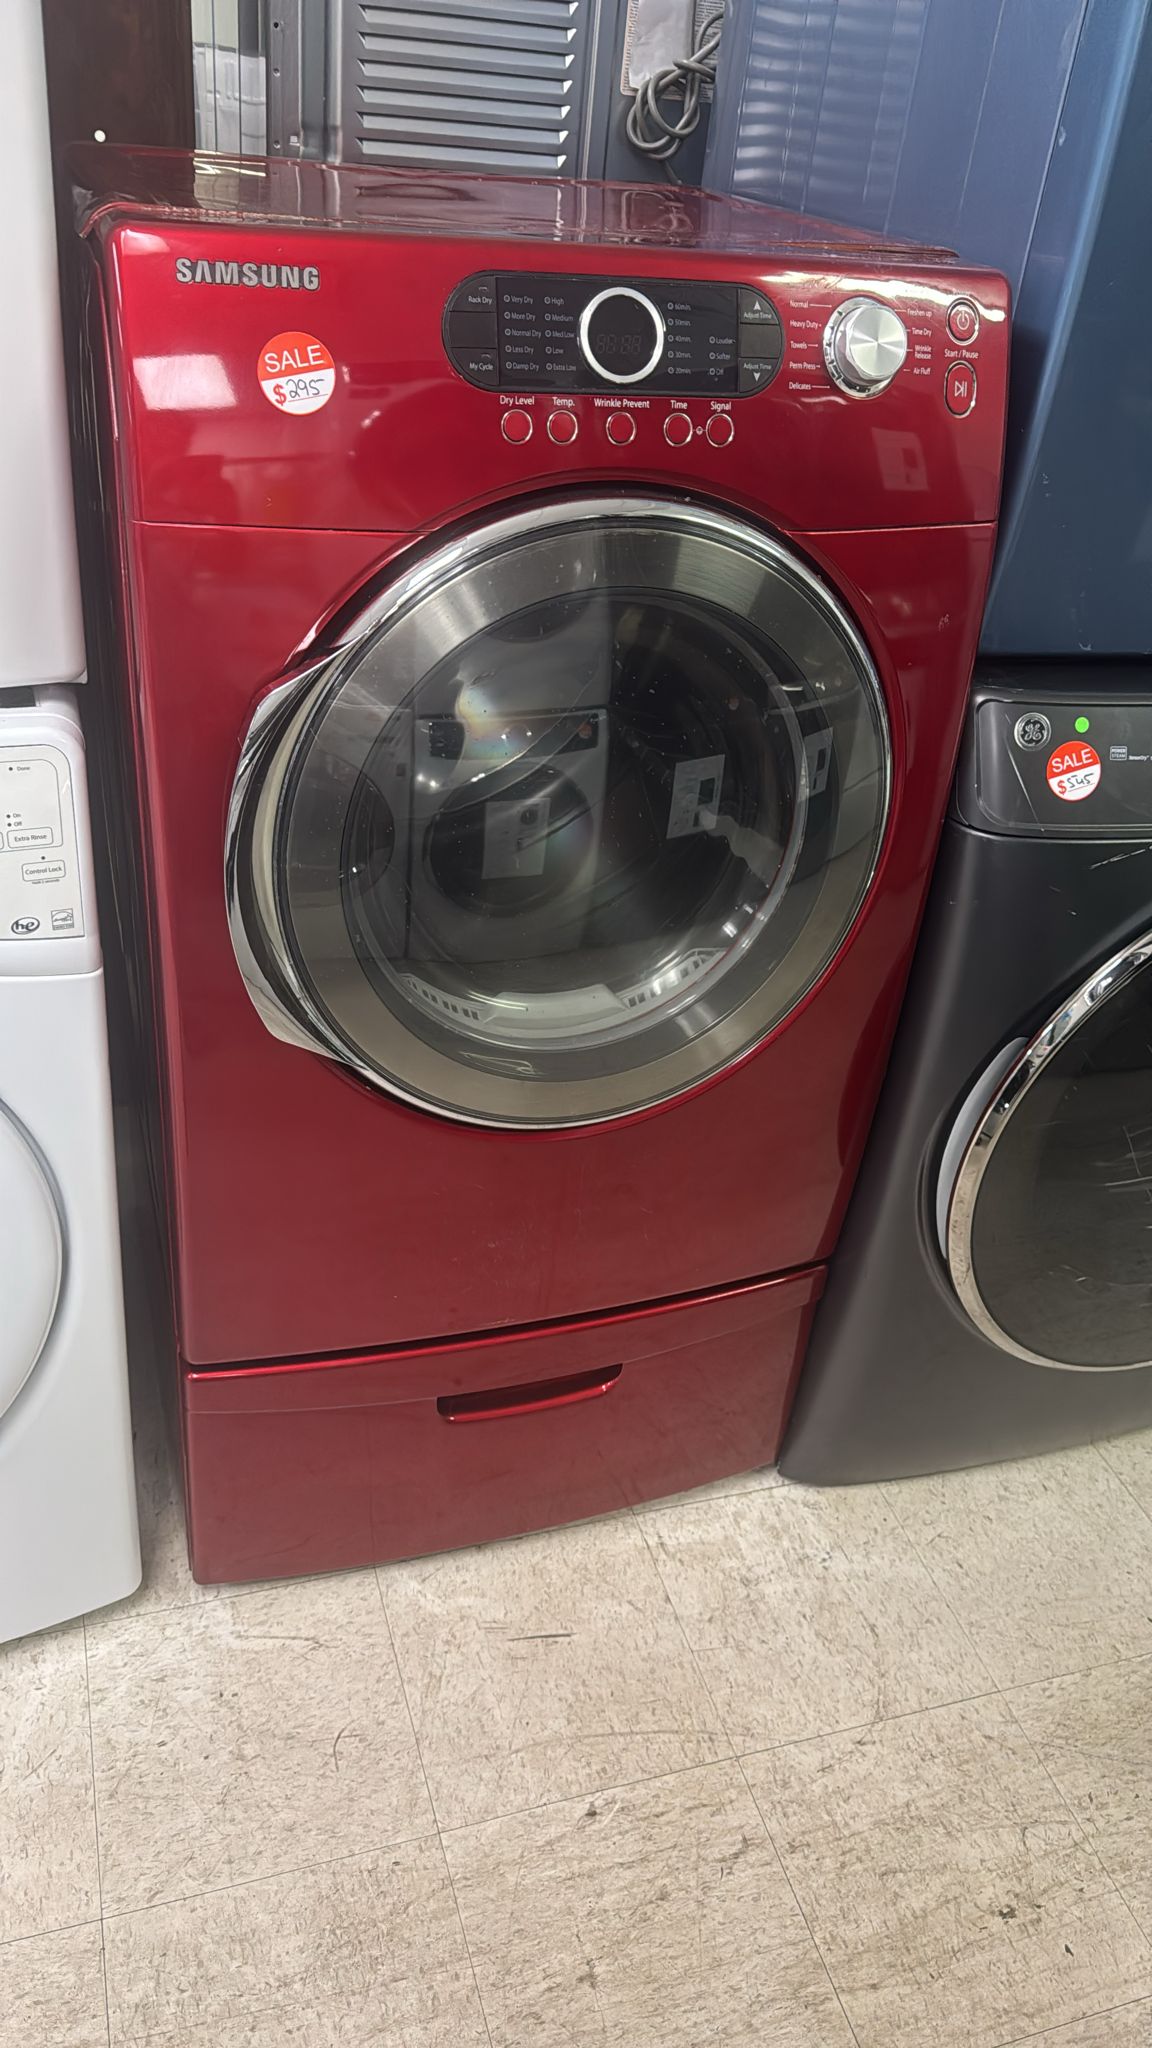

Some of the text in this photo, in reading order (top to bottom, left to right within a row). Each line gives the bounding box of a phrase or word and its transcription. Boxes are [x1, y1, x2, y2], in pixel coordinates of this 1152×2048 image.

[175, 257, 320, 291] SAMSUNG
[482, 297, 493, 305] Dry
[524, 296, 534, 304] Dry
[551, 297, 564, 306] High
[789, 300, 808, 308] Normal
[744, 312, 759, 320] Adjust
[907, 308, 924, 316] Freshen
[526, 313, 536, 321] Dry
[790, 320, 818, 330] Heavy Duty
[512, 328, 542, 338] Normal Dry
[921, 328, 932, 336] Dry
[525, 346, 534, 354] Dry
[790, 341, 807, 350] Towels
[264, 343, 326, 374] SALE
[716, 352, 730, 360] Softer
[944, 349, 958, 358] Start
[962, 350, 978, 359] Pause
[470, 362, 494, 371] My Cycle
[530, 363, 539, 371] Dry
[553, 363, 565, 371] Extra
[789, 362, 816, 370] Perm Press
[913, 367, 931, 375] Air Fluff
[788, 382, 812, 391] Delicates
[273, 378, 325, 406] $295
[500, 396, 535, 406] Dry Level
[552, 397, 576, 408] Temp.
[594, 398, 650, 409] Wrinkle Prevent
[671, 400, 688, 409] Time
[711, 401, 731, 411] Signal
[1051, 748, 1093, 773] SALE
[1057, 772, 1095, 795] $545
